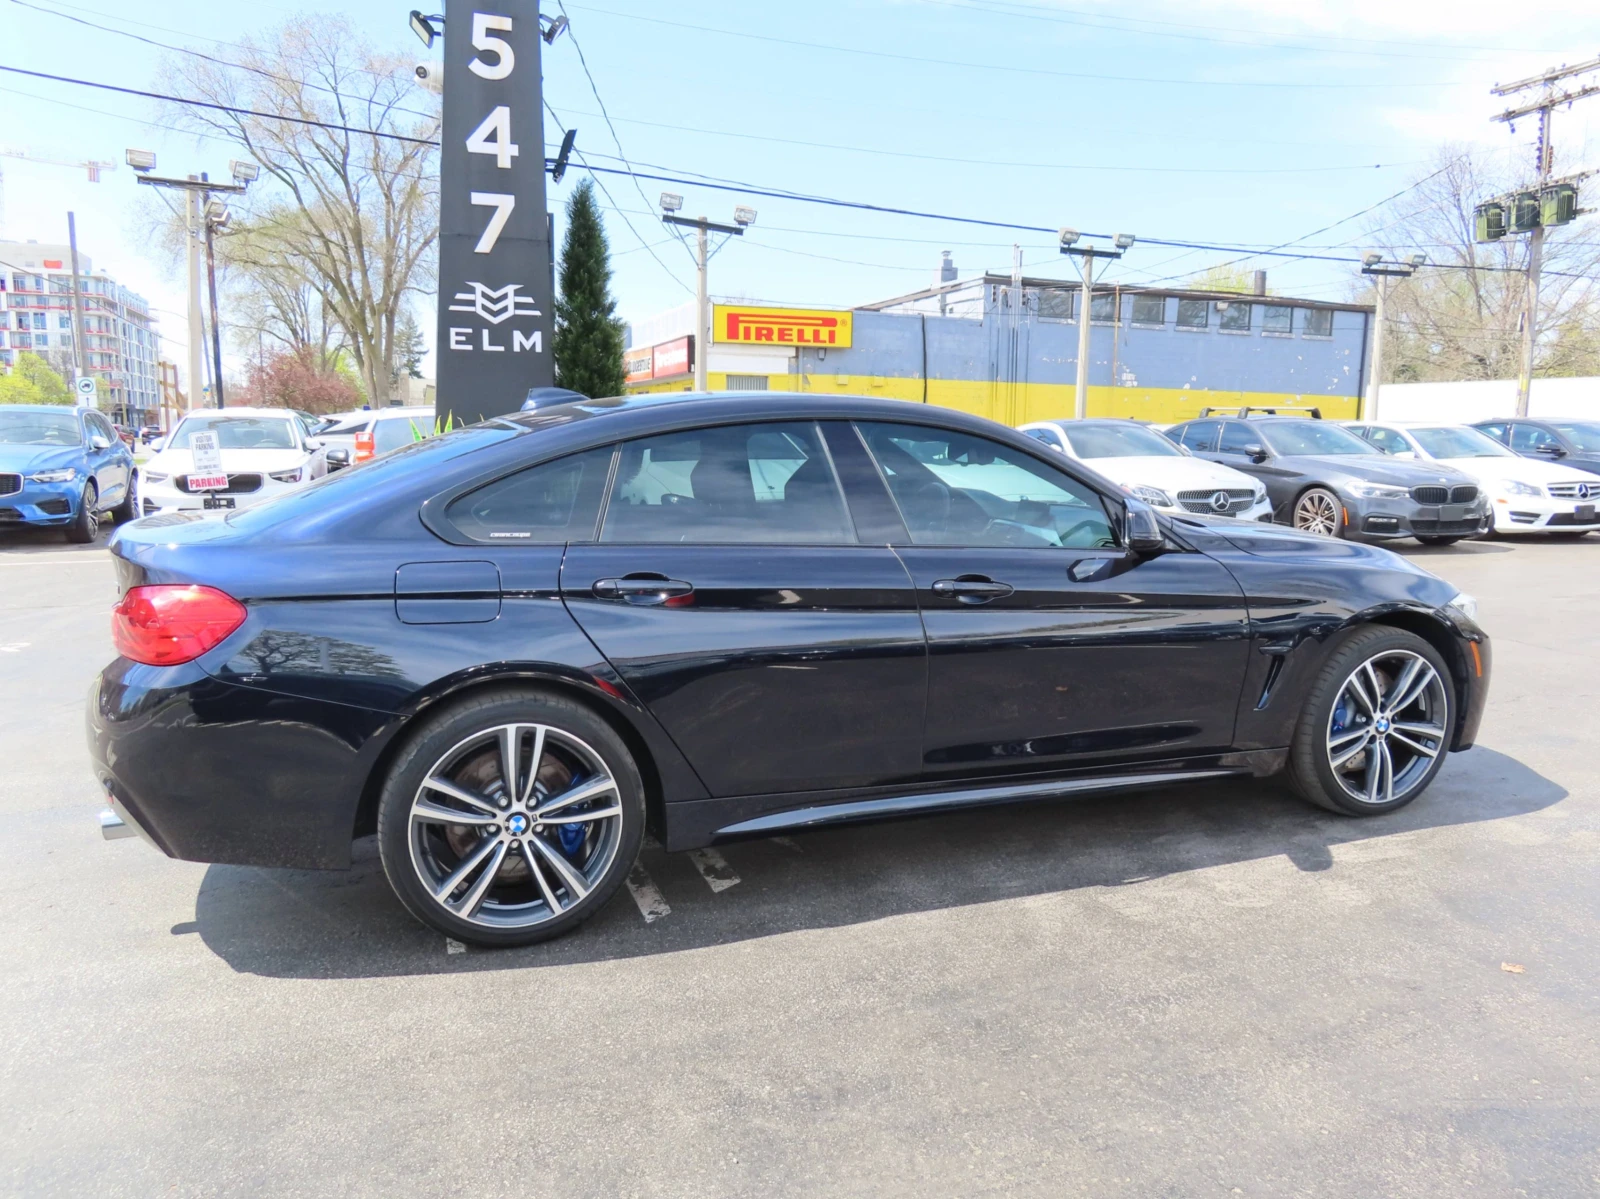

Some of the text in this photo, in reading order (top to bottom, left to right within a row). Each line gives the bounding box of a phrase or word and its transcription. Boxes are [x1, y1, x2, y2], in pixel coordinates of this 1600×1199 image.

[449, 327, 542, 353] ELM
[727, 313, 837, 343] PIRELLI
[189, 476, 227, 488] PARKING
